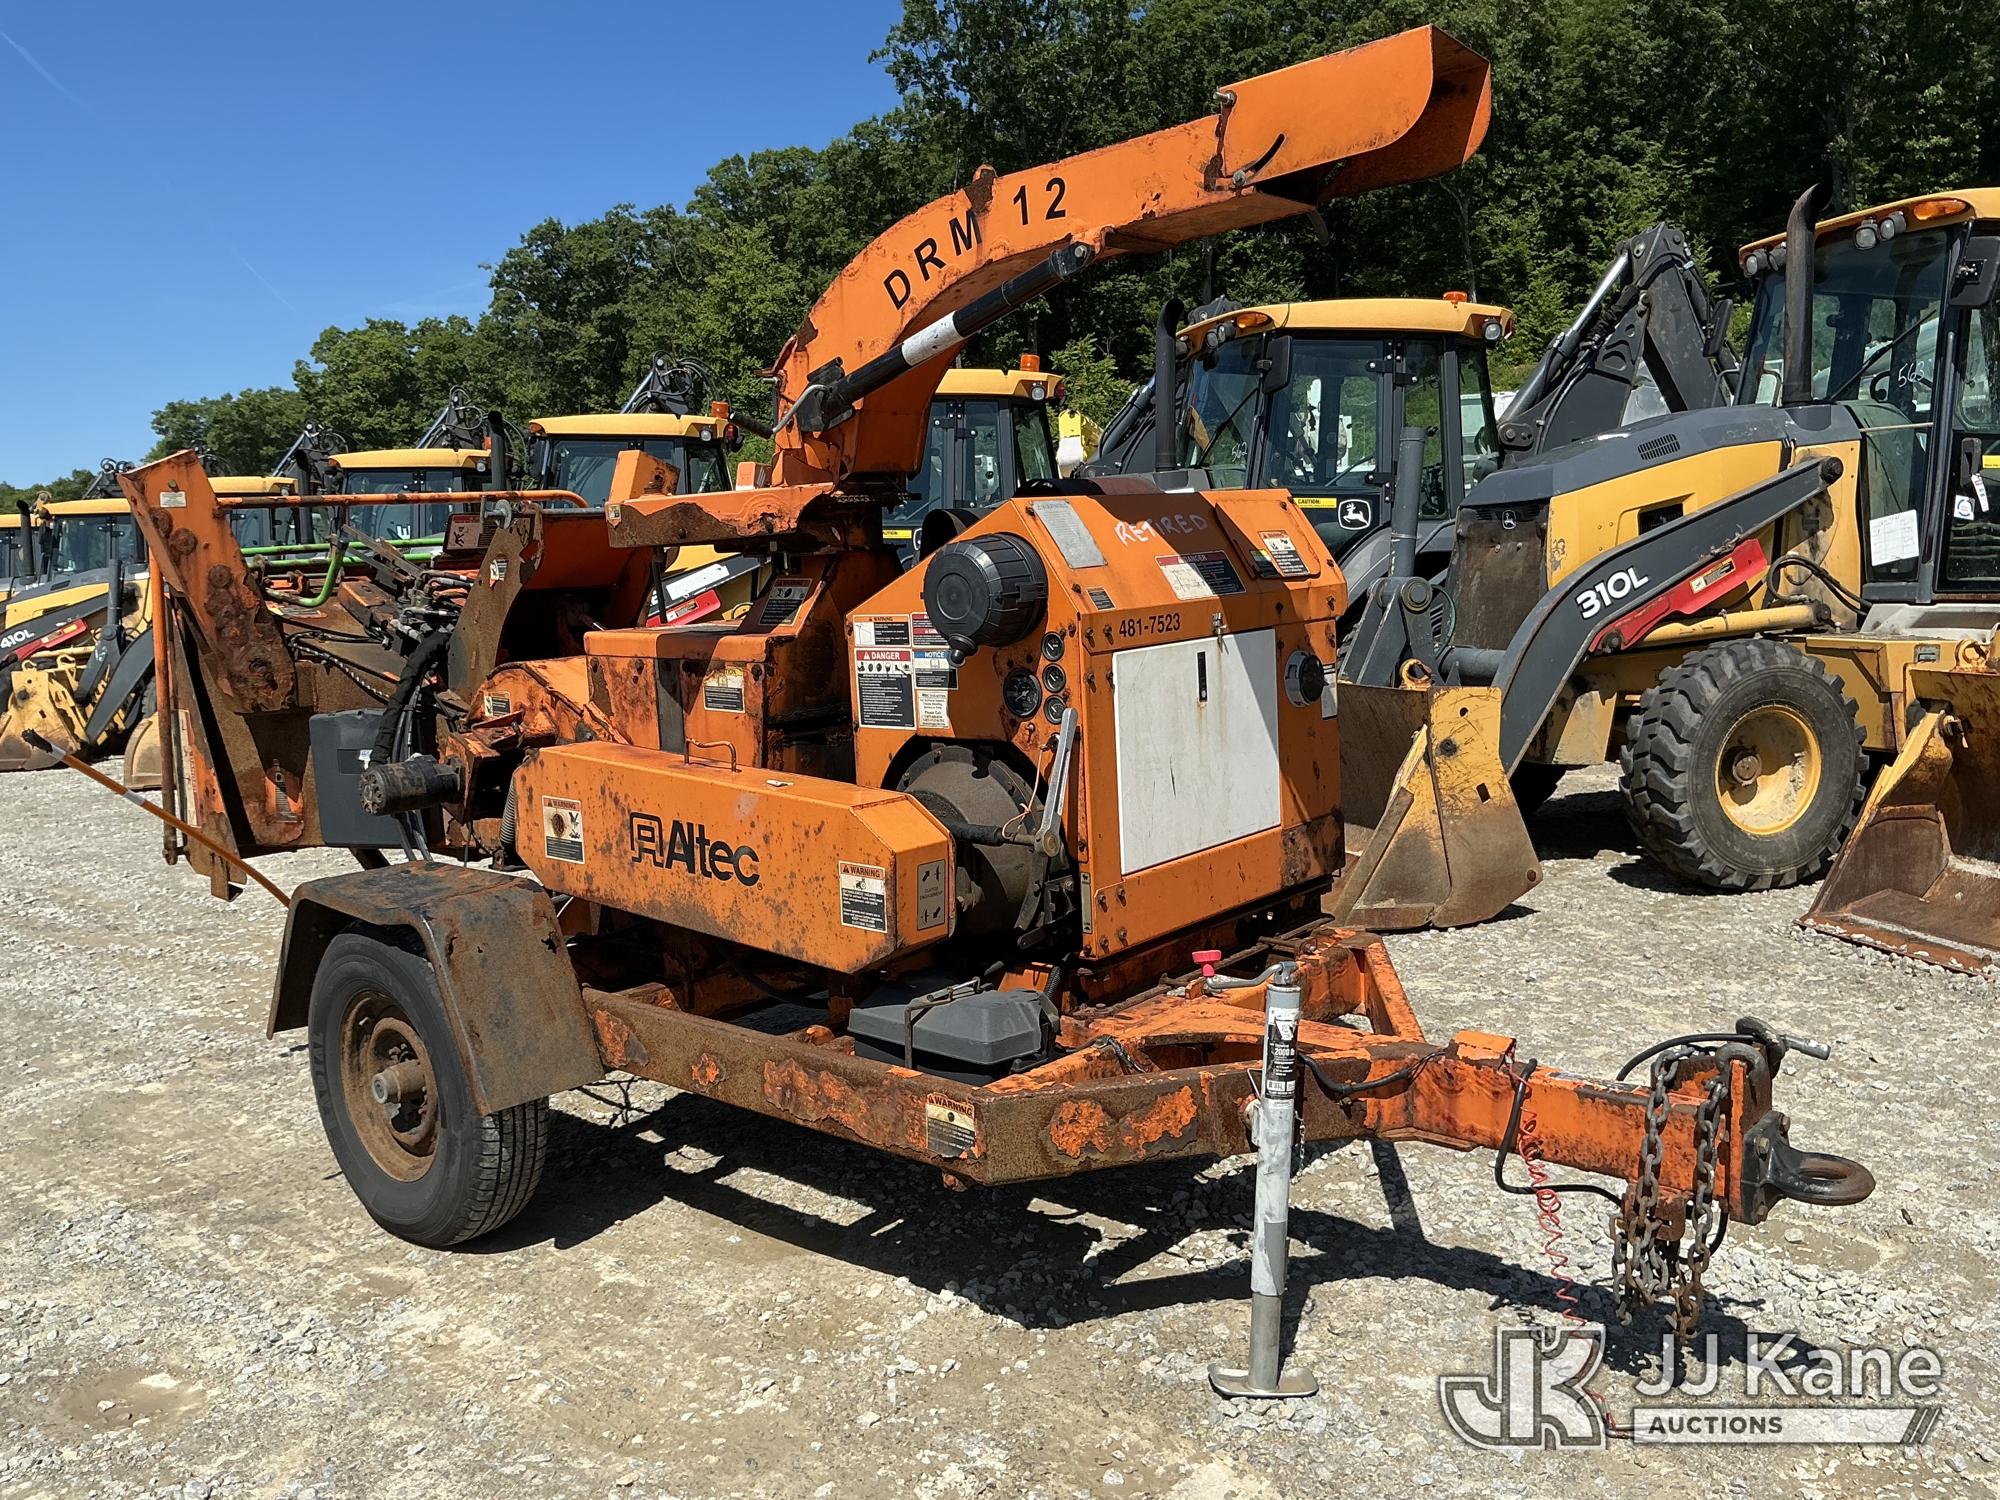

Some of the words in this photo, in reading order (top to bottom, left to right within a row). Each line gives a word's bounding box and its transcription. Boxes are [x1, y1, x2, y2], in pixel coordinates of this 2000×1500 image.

[884, 209, 982, 310] DRM
[1013, 177, 1066, 226] 12
[1898, 361, 1925, 387] 563
[1231, 442, 1247, 462] 562
[1115, 513, 1208, 546] RETIRED
[1577, 566, 1649, 620] 310L
[1118, 612, 1181, 638] 481-7523
[0, 629, 35, 649] 410L
[871, 651, 900, 660] DANGER
[553, 800, 577, 810] WARNING
[665, 819, 760, 887] Altec
[850, 866, 881, 878] WARNING
[1274, 1047, 1290, 1056] 2000
[934, 1096, 972, 1116] WARNING
